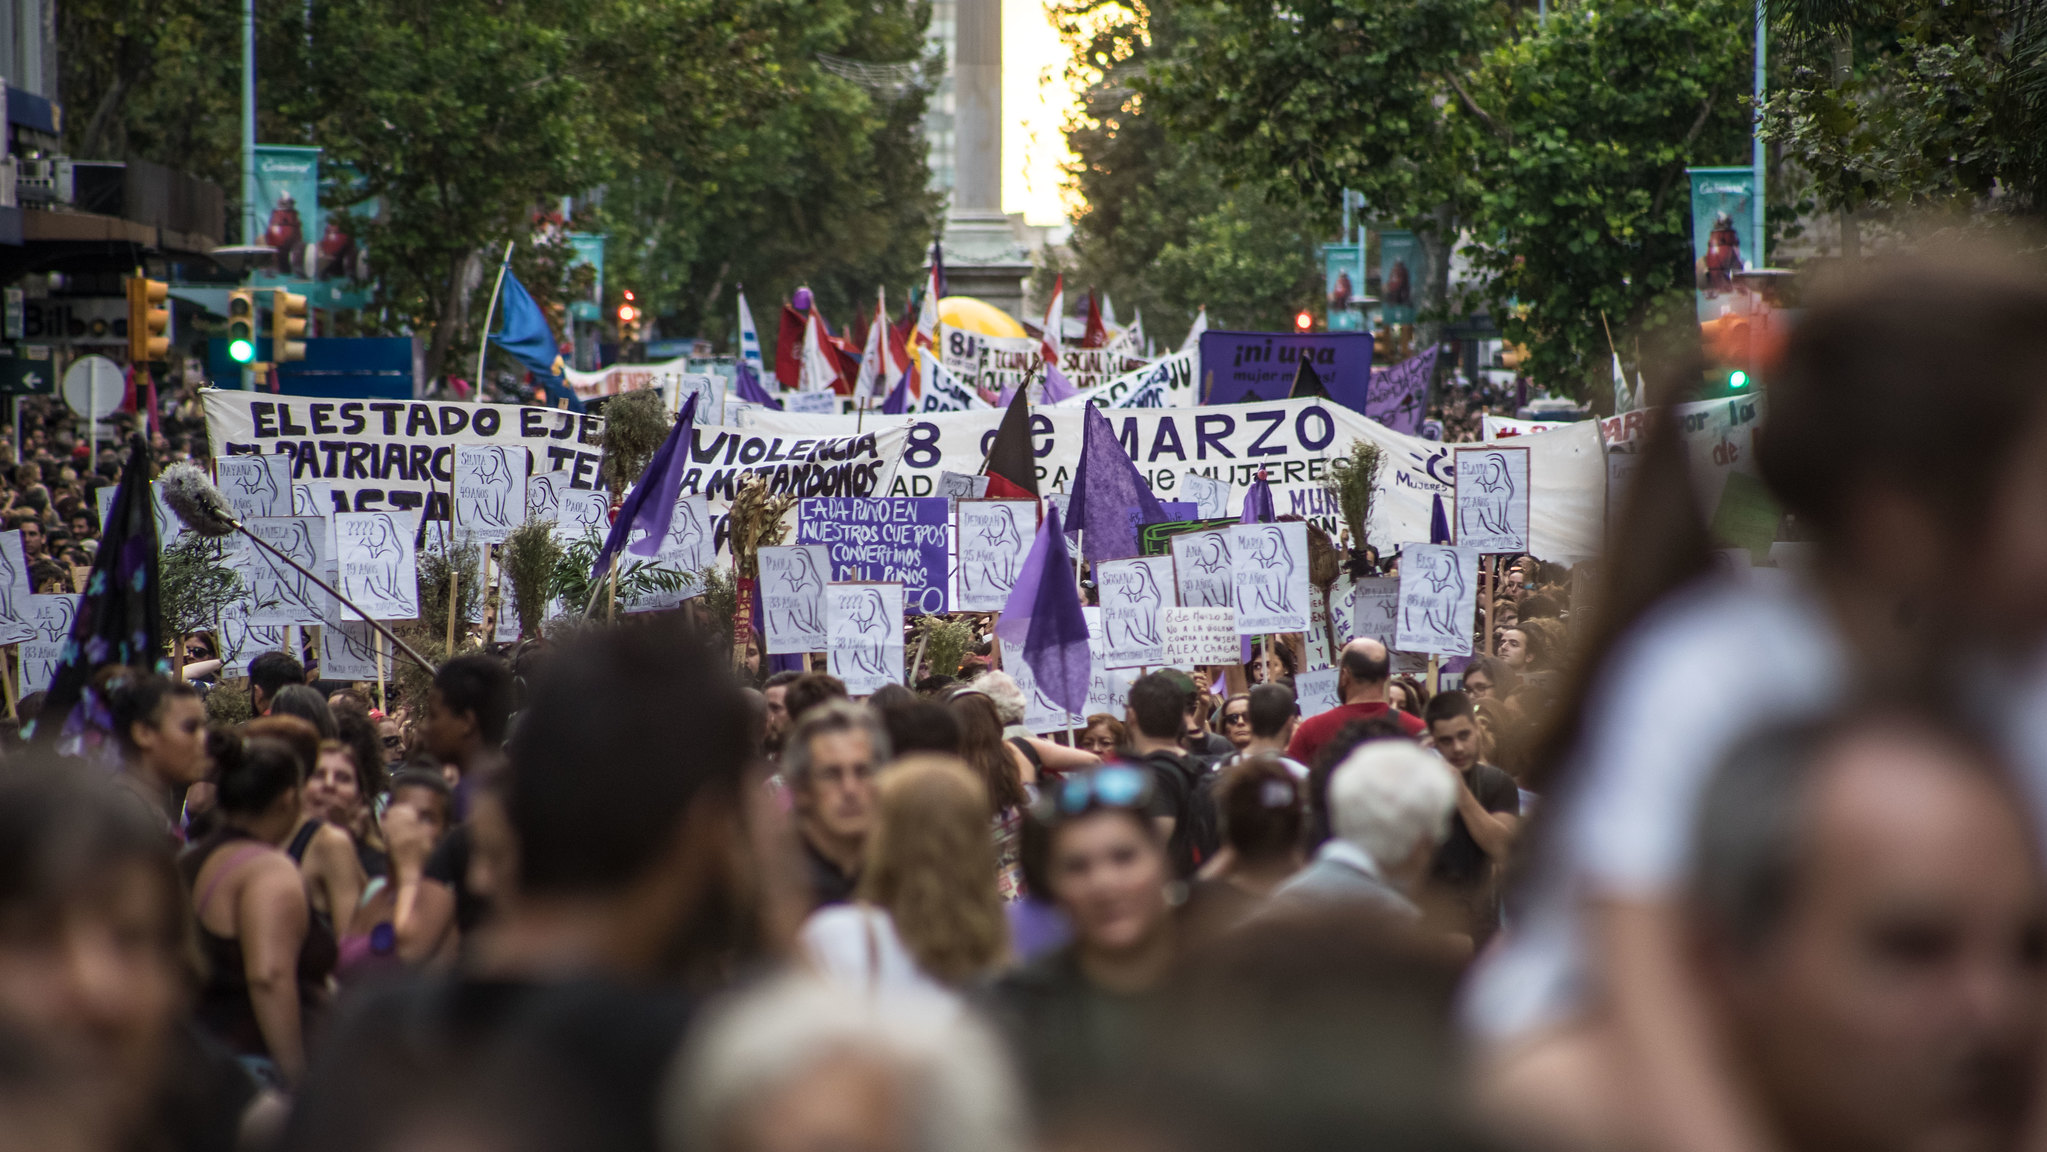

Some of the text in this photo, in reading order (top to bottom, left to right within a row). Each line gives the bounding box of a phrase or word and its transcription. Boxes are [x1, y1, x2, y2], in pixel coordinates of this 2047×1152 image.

[250, 402, 605, 444] EL ESTADO EJE
[903, 422, 942, 469] 8
[1104, 405, 1336, 462] MARZO
[1601, 411, 1652, 443] MAR
[690, 428, 879, 466] VIOLENCIA
[705, 459, 885, 503] MATANDONOS
[890, 474, 932, 498] AD
[1189, 457, 1352, 488] MUJERES
[800, 498, 918, 523] CADA PUÑO EN
[1289, 488, 1340, 516] MUN
[346, 520, 374, 536] ????
[802, 520, 949, 548] NUESTROS CUERPOS
[1167, 644, 1200, 656] ALEX
